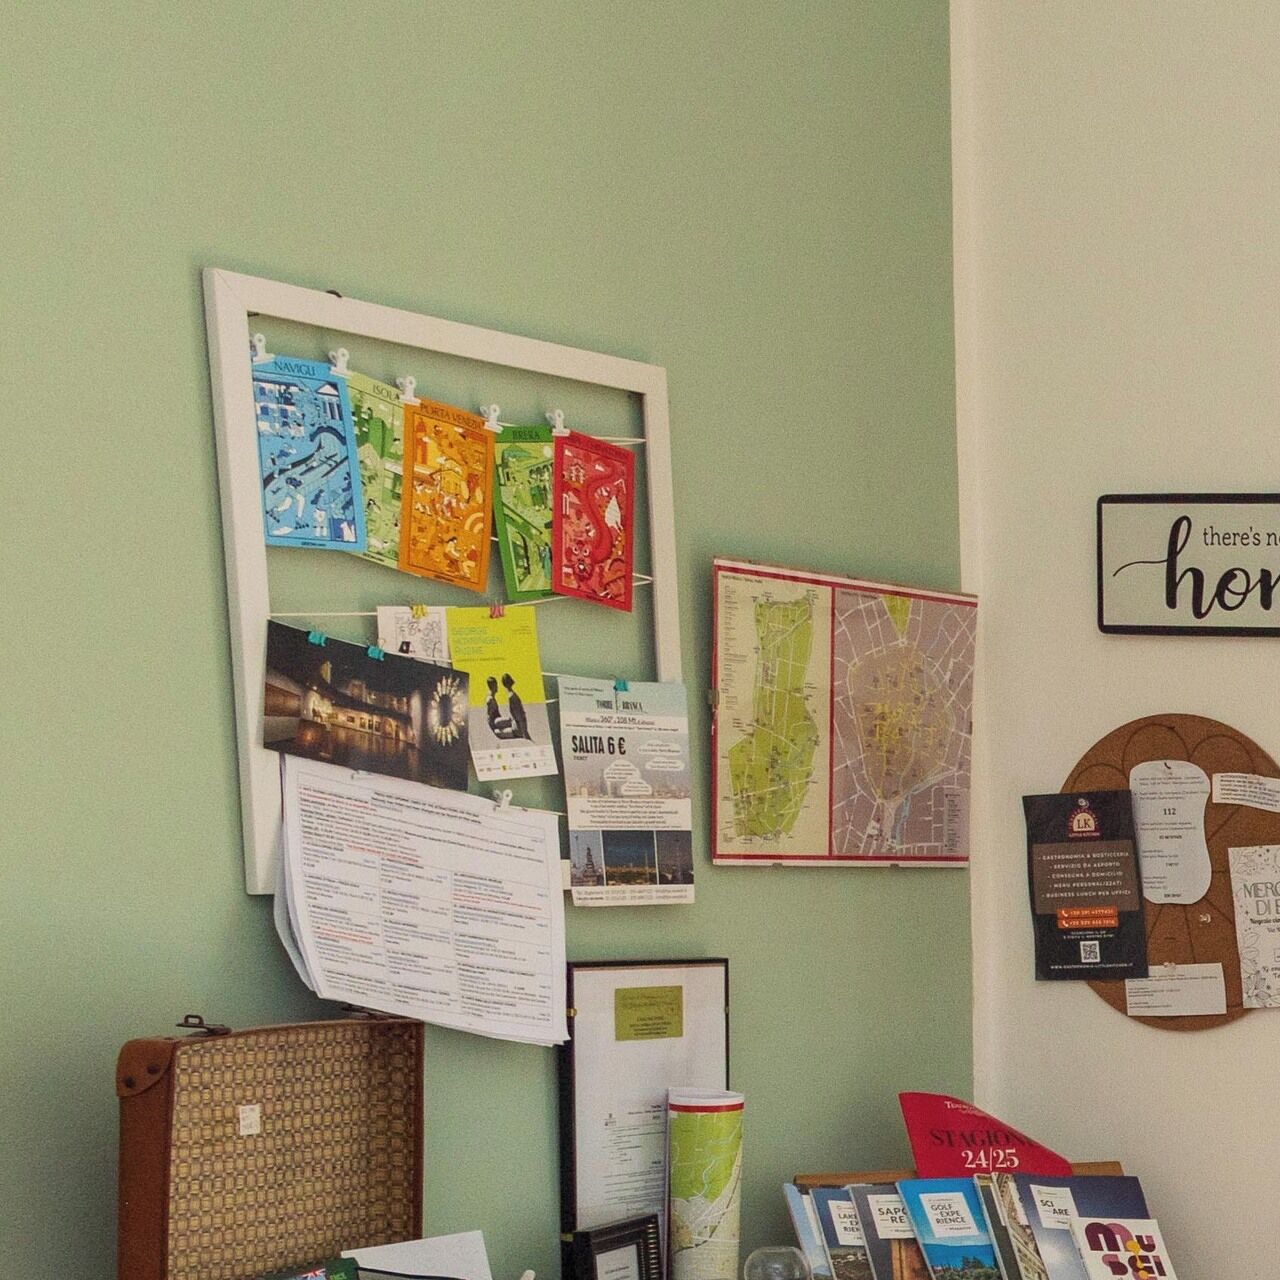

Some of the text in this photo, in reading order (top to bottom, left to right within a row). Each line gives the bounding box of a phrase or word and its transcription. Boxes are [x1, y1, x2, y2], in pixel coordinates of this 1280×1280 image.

[1203, 526, 1261, 547] there's
[571, 735, 605, 754] SALITA
[607, 736, 615, 755] 6
[618, 737, 626, 755] €
[1163, 808, 1176, 816] 112
[1076, 818, 1091, 829] LK
[1255, 899, 1271, 916] DI
[930, 1204, 952, 1212] GOLF
[1040, 1200, 1054, 1208] SCI
[1052, 1208, 1070, 1216] ARE
[935, 1216, 967, 1224] RIENCE
